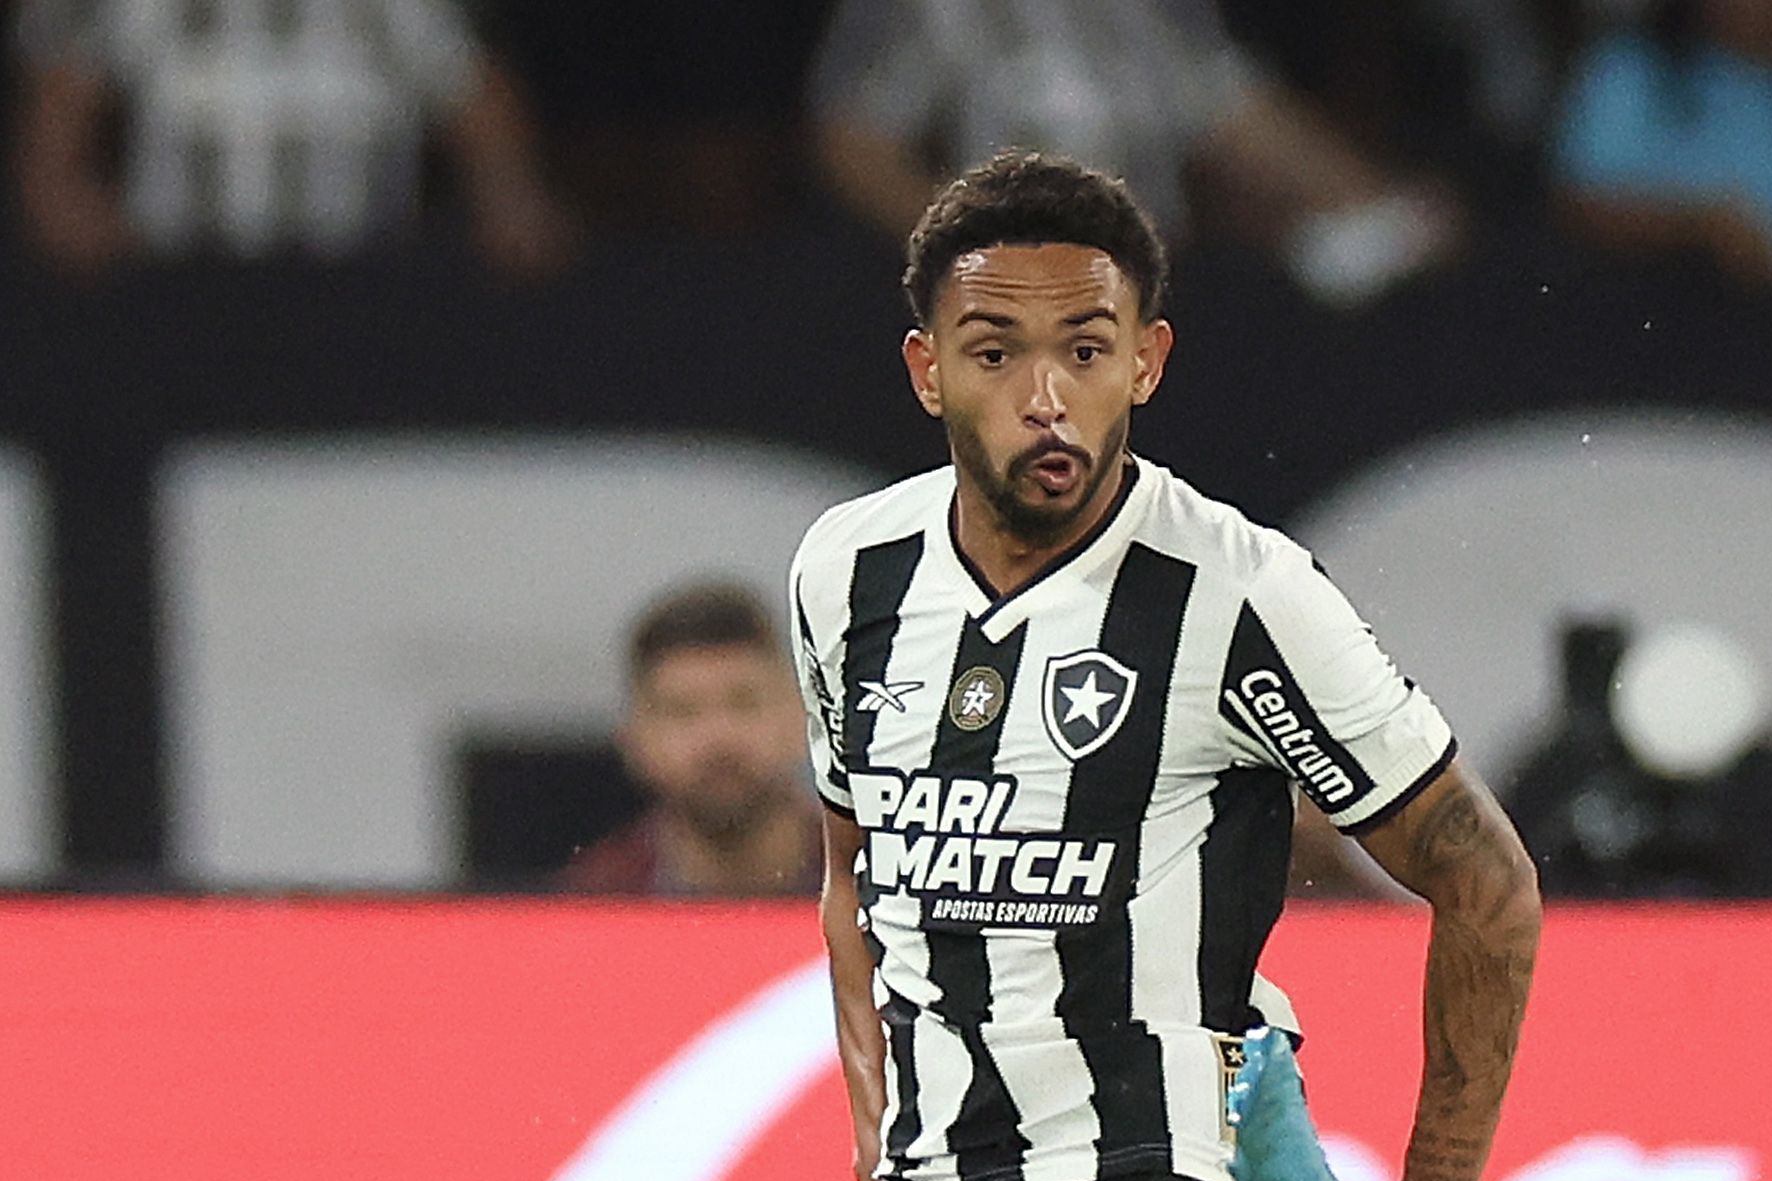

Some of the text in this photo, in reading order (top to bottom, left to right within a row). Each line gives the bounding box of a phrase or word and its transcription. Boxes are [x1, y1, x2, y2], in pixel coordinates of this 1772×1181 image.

[1240, 669, 1354, 803] Centrum
[848, 772, 1011, 835] PARI
[869, 831, 1116, 896] MATCH
[931, 899, 1099, 924] APOSTAS ESPORTIVAS
